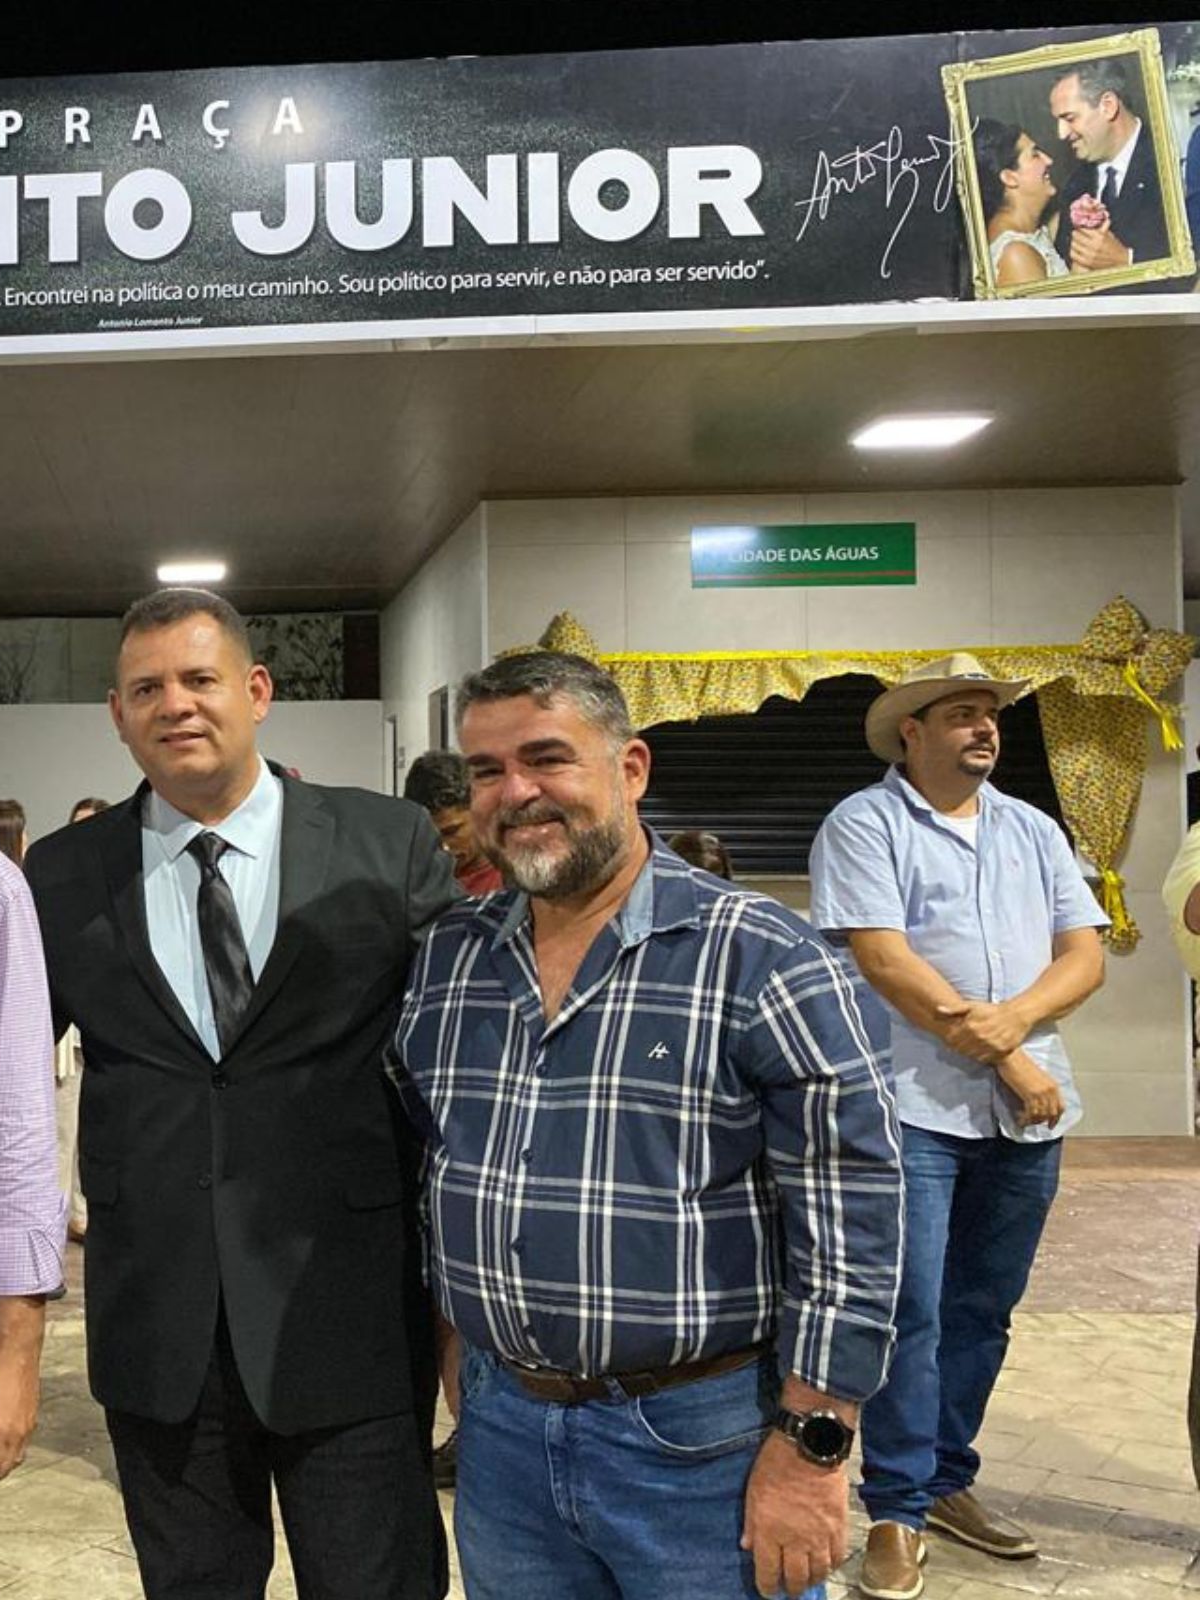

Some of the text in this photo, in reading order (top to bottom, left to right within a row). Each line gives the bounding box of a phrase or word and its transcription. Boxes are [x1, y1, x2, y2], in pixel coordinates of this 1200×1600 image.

[232, 145, 765, 256] JUNIOR
[5, 286, 88, 306] Encontrei
[92, 287, 114, 303] na
[118, 282, 183, 306] política
[186, 285, 199, 299] o
[202, 283, 245, 299] meu
[248, 275, 334, 297] caminho.
[338, 273, 374, 293] Sou
[378, 270, 447, 296] político
[451, 272, 492, 293] para
[496, 267, 550, 288] servir,
[553, 270, 566, 285] e
[569, 265, 606, 284] não
[609, 265, 651, 288] para
[656, 266, 684, 282] ser
[790, 548, 821, 561] DAS
[825, 545, 879, 561] ÁGUAS
